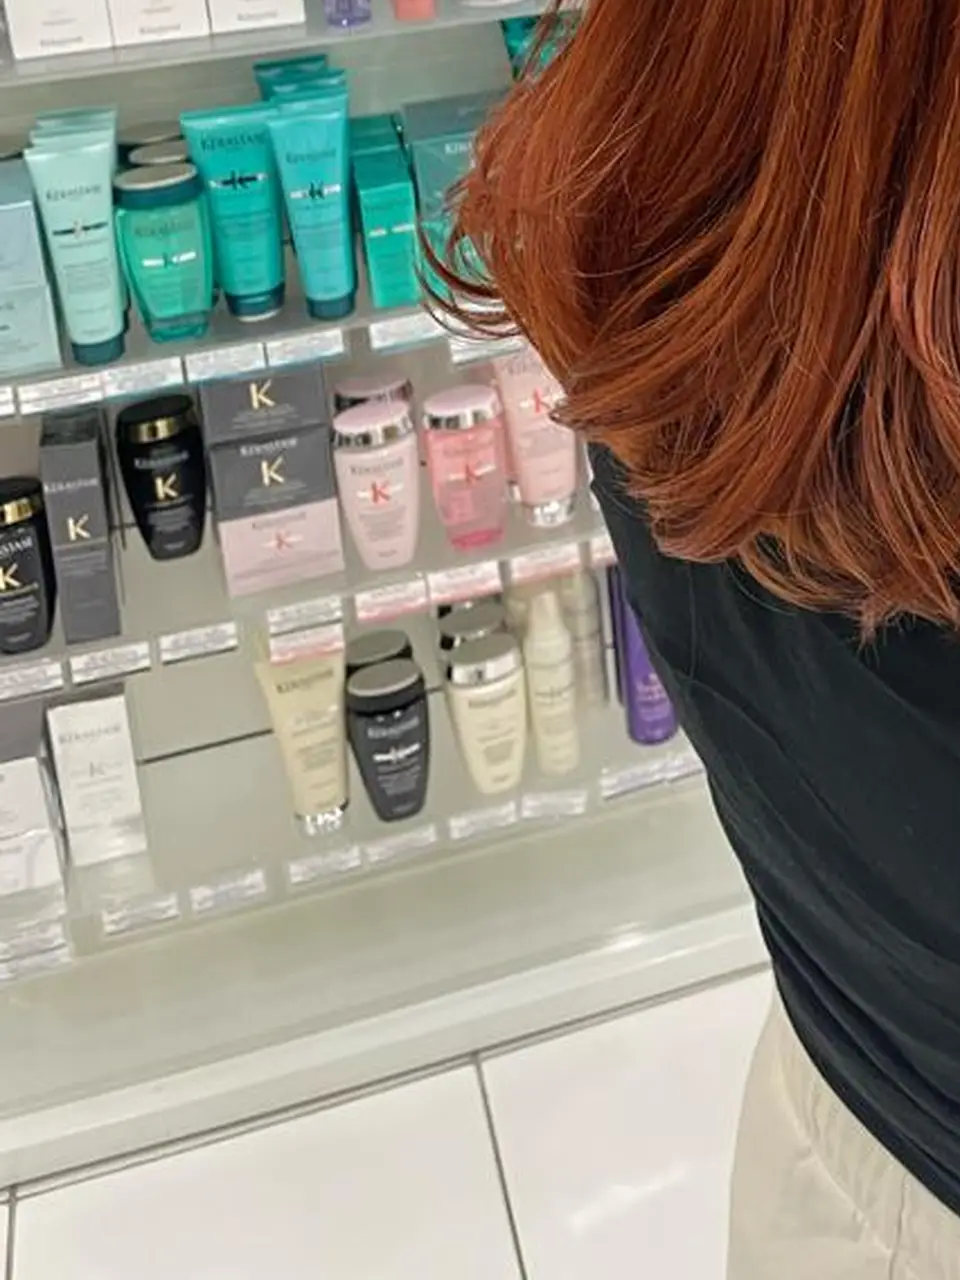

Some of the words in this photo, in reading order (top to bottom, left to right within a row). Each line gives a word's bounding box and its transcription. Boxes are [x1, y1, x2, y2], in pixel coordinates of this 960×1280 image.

[250, 379, 276, 410] K
[261, 456, 285, 487] K
[155, 473, 178, 500] K
[67, 514, 90, 540] K
